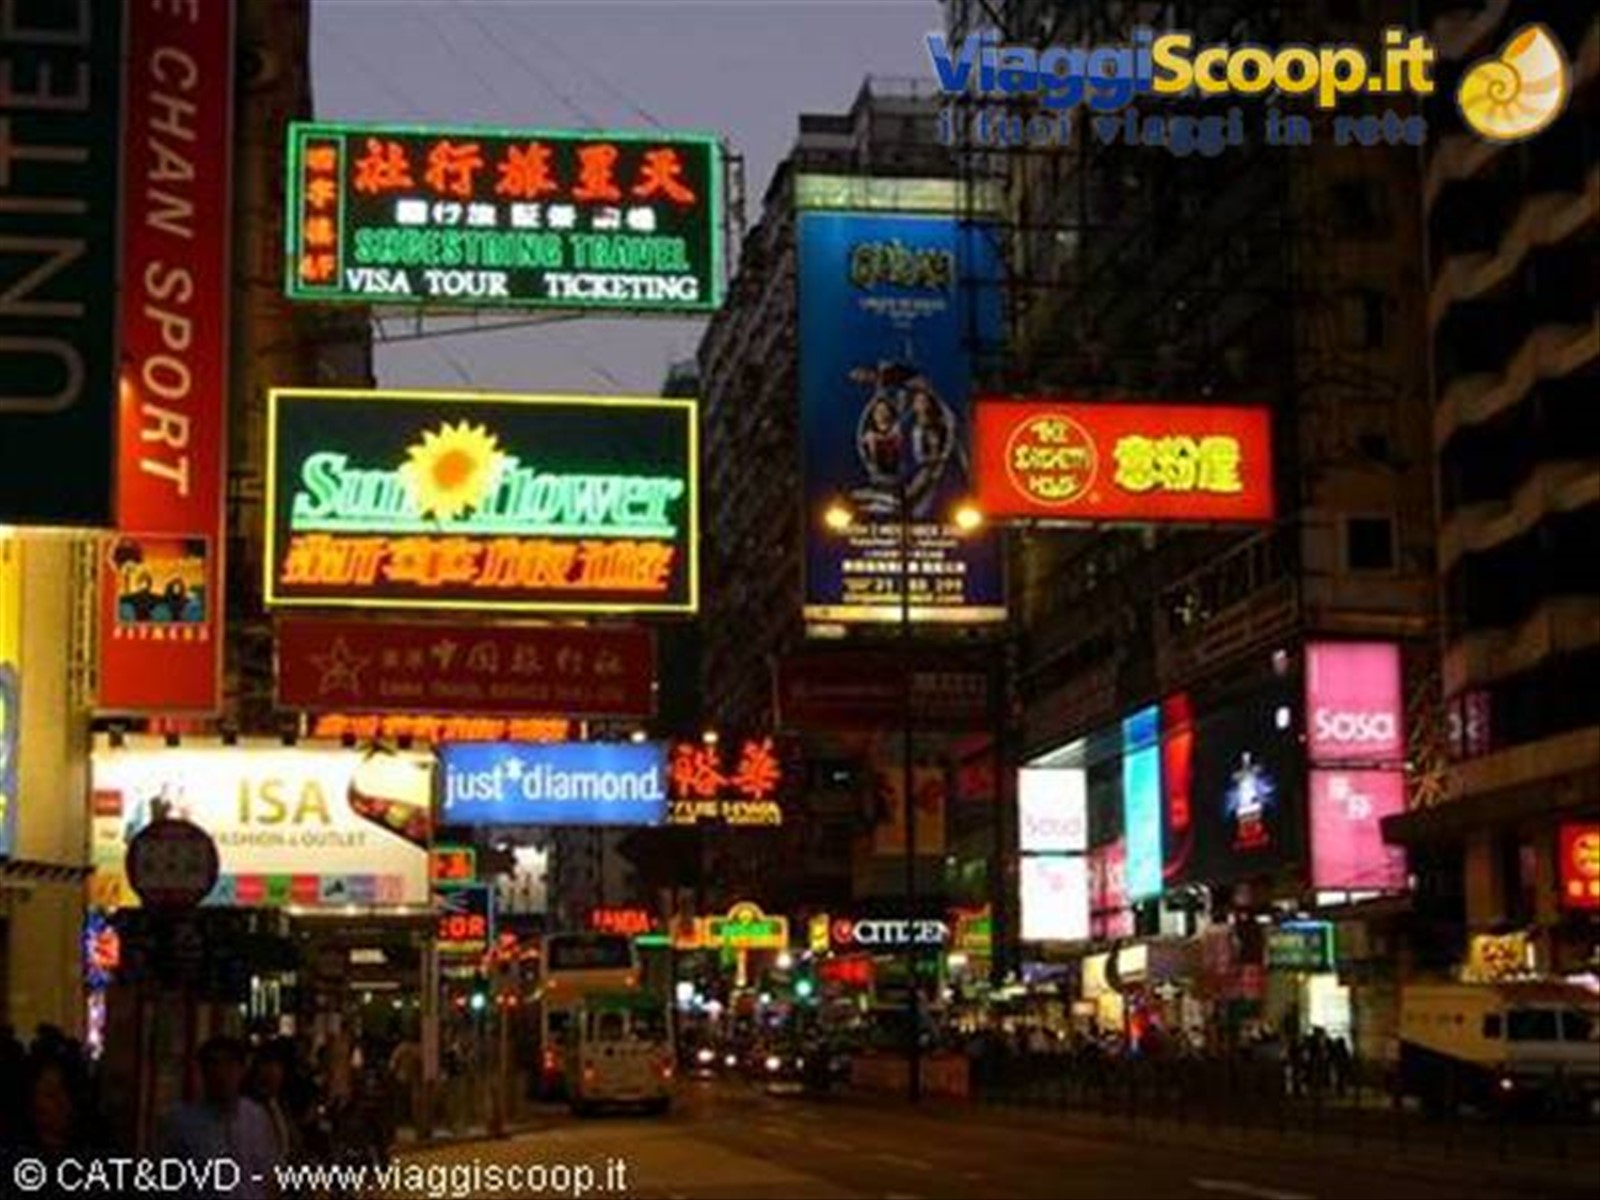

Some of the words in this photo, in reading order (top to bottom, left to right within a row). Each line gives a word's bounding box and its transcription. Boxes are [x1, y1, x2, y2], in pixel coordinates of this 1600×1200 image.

[146, 47, 199, 238] CHAN
[346, 269, 411, 295] VISA
[424, 271, 509, 297] TOUR
[544, 274, 698, 300] TICKETING
[139, 261, 194, 497] SPORT
[236, 777, 331, 824] ISA
